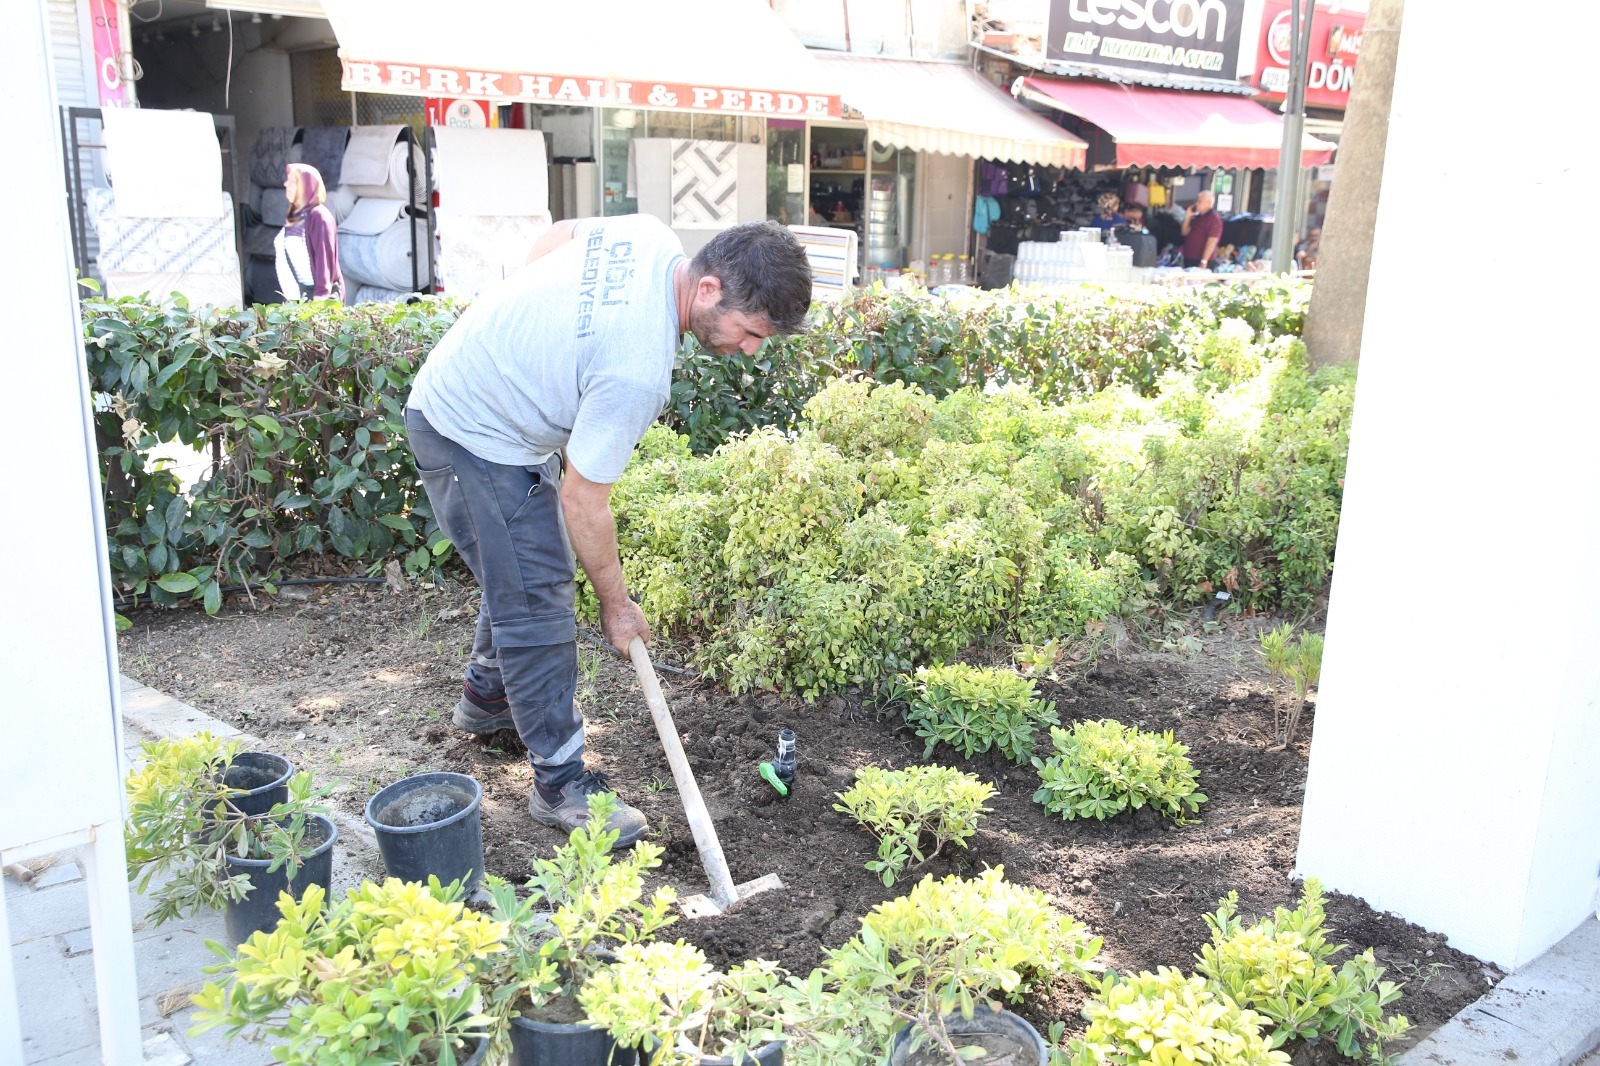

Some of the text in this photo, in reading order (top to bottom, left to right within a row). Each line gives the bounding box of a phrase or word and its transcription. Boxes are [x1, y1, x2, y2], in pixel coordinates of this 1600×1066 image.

[348, 62, 504, 96] BERK
[648, 84, 678, 107] &
[692, 87, 830, 116] PERDE
[576, 227, 604, 339] BELEDİYESİ
[601, 240, 636, 306] ÇİĞLİ
